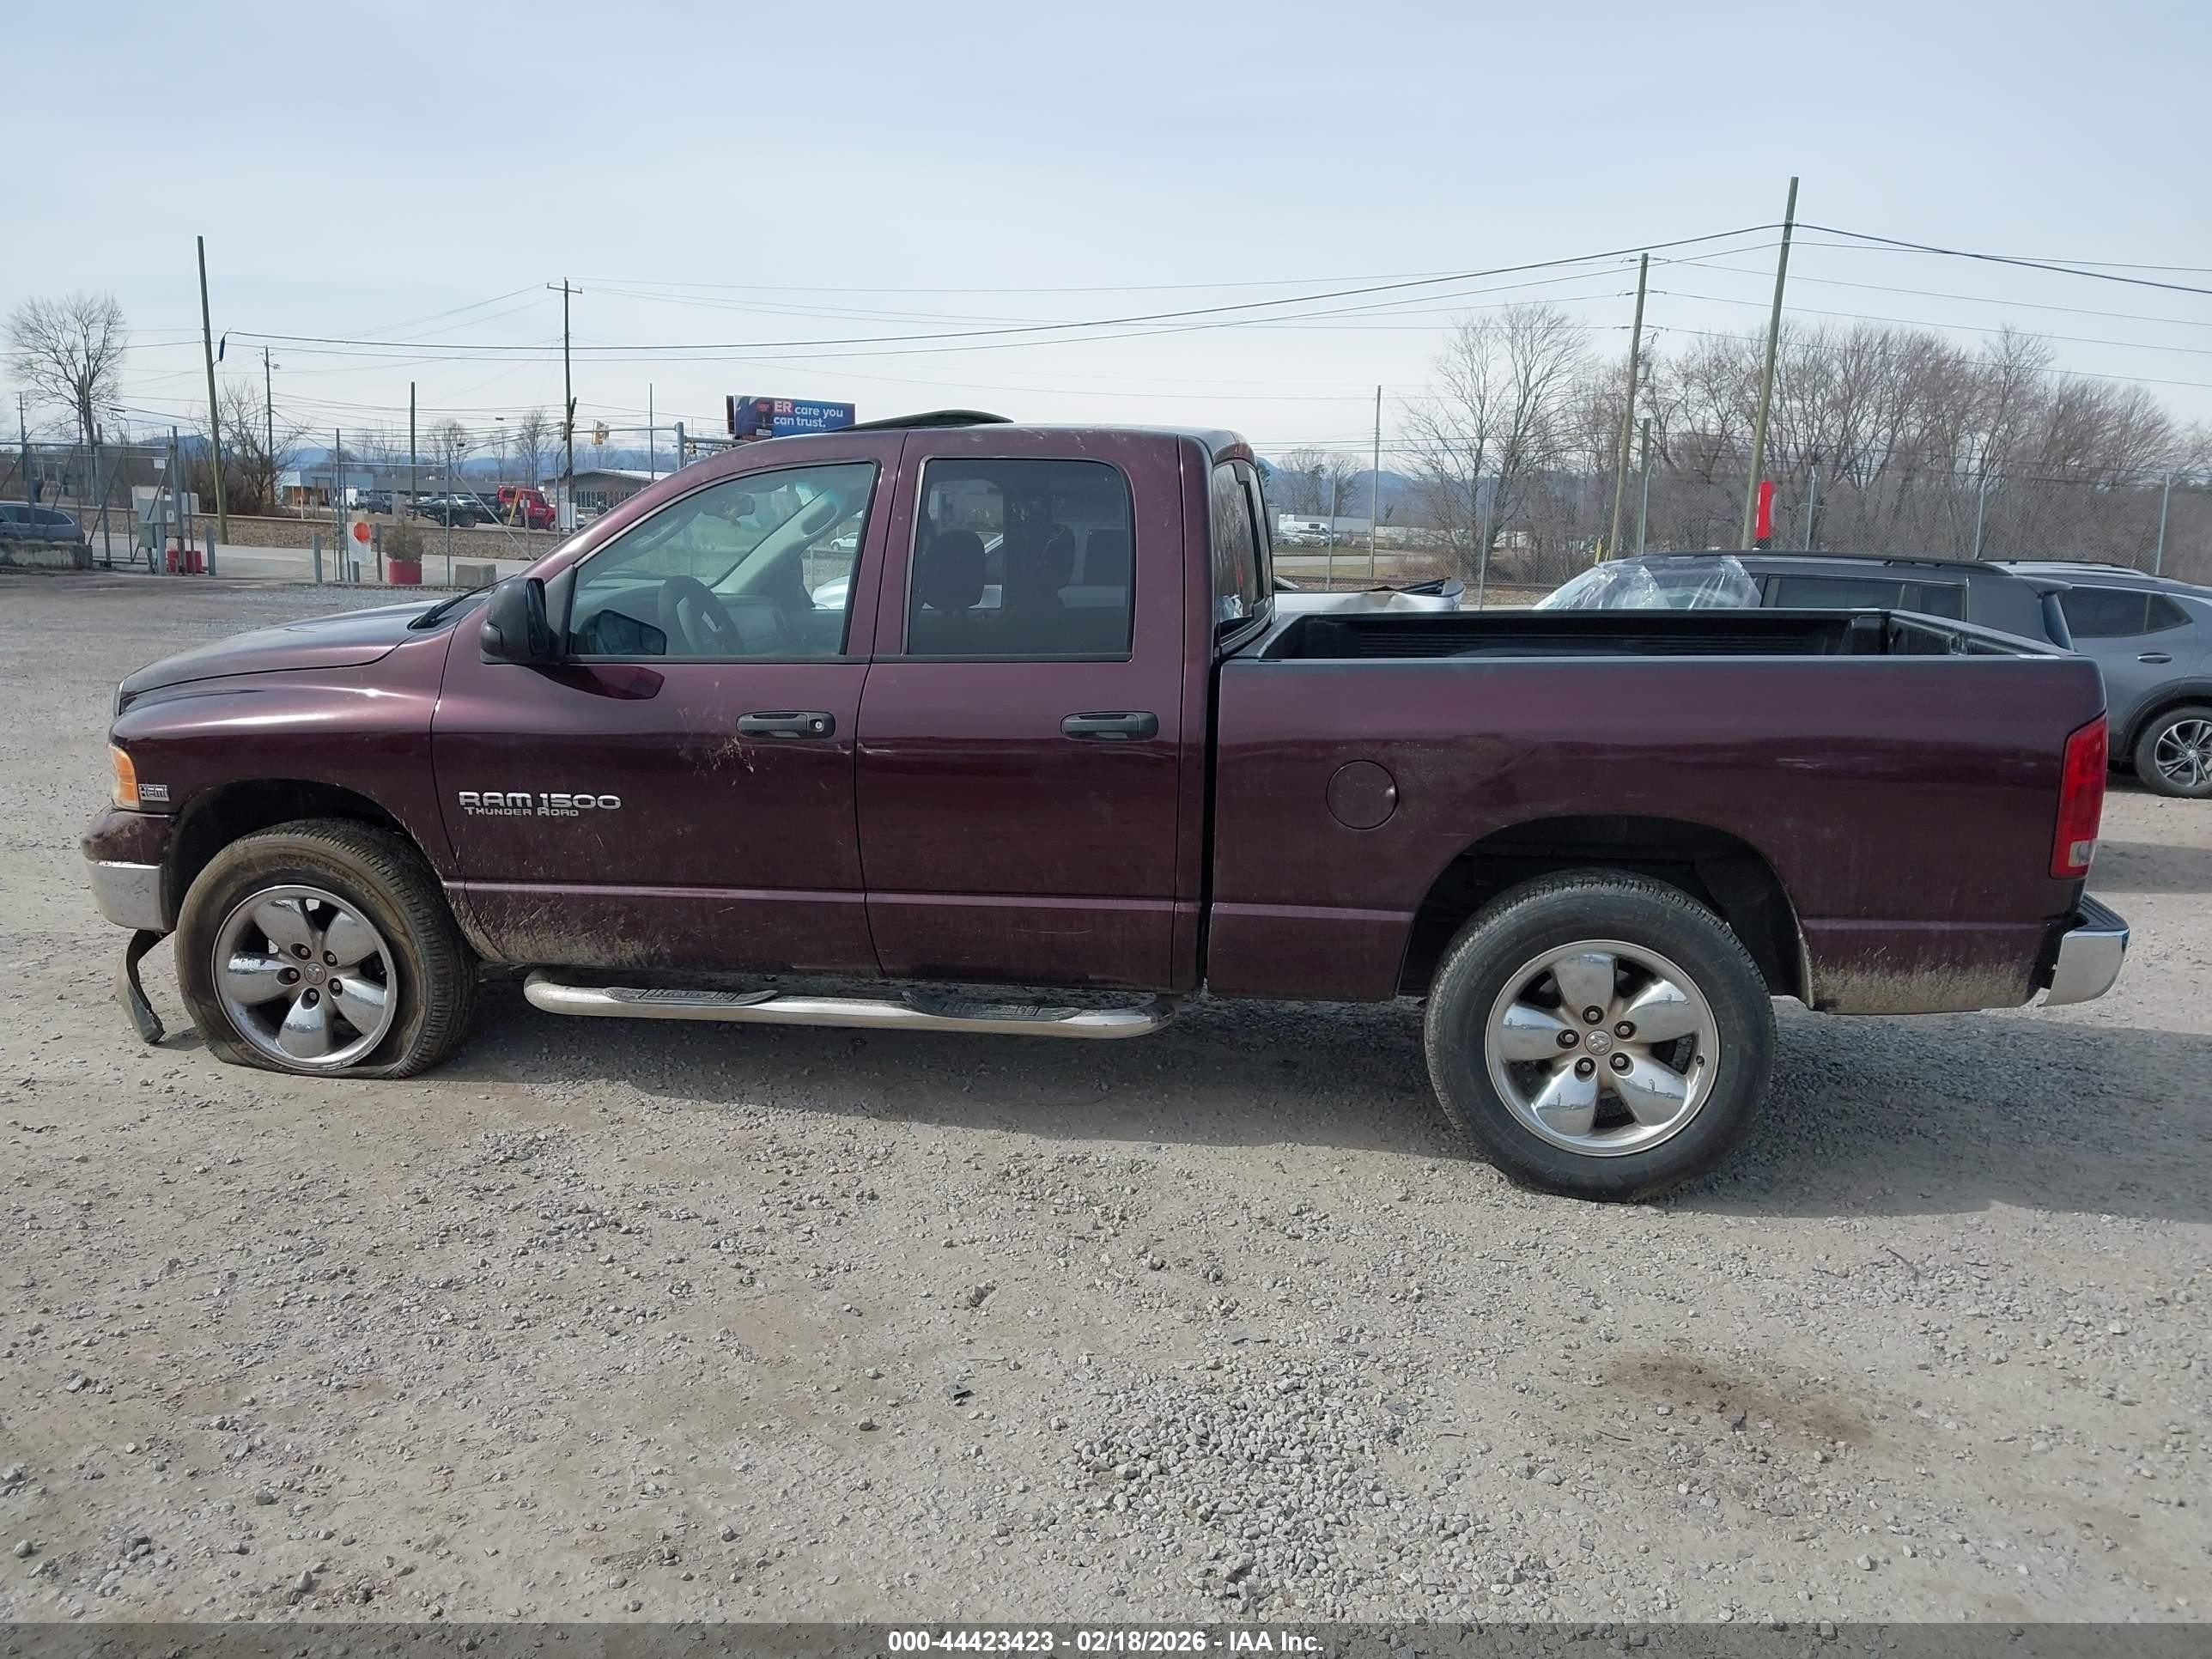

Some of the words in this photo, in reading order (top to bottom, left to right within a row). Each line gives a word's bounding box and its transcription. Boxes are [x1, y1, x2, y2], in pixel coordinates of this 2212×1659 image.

[774, 401, 792, 413] ER
[794, 406, 820, 416] care
[823, 409, 843, 418] you
[774, 416, 794, 425] can
[797, 417, 826, 428] trust.
[459, 791, 532, 807] RAM
[539, 793, 622, 810] 1500
